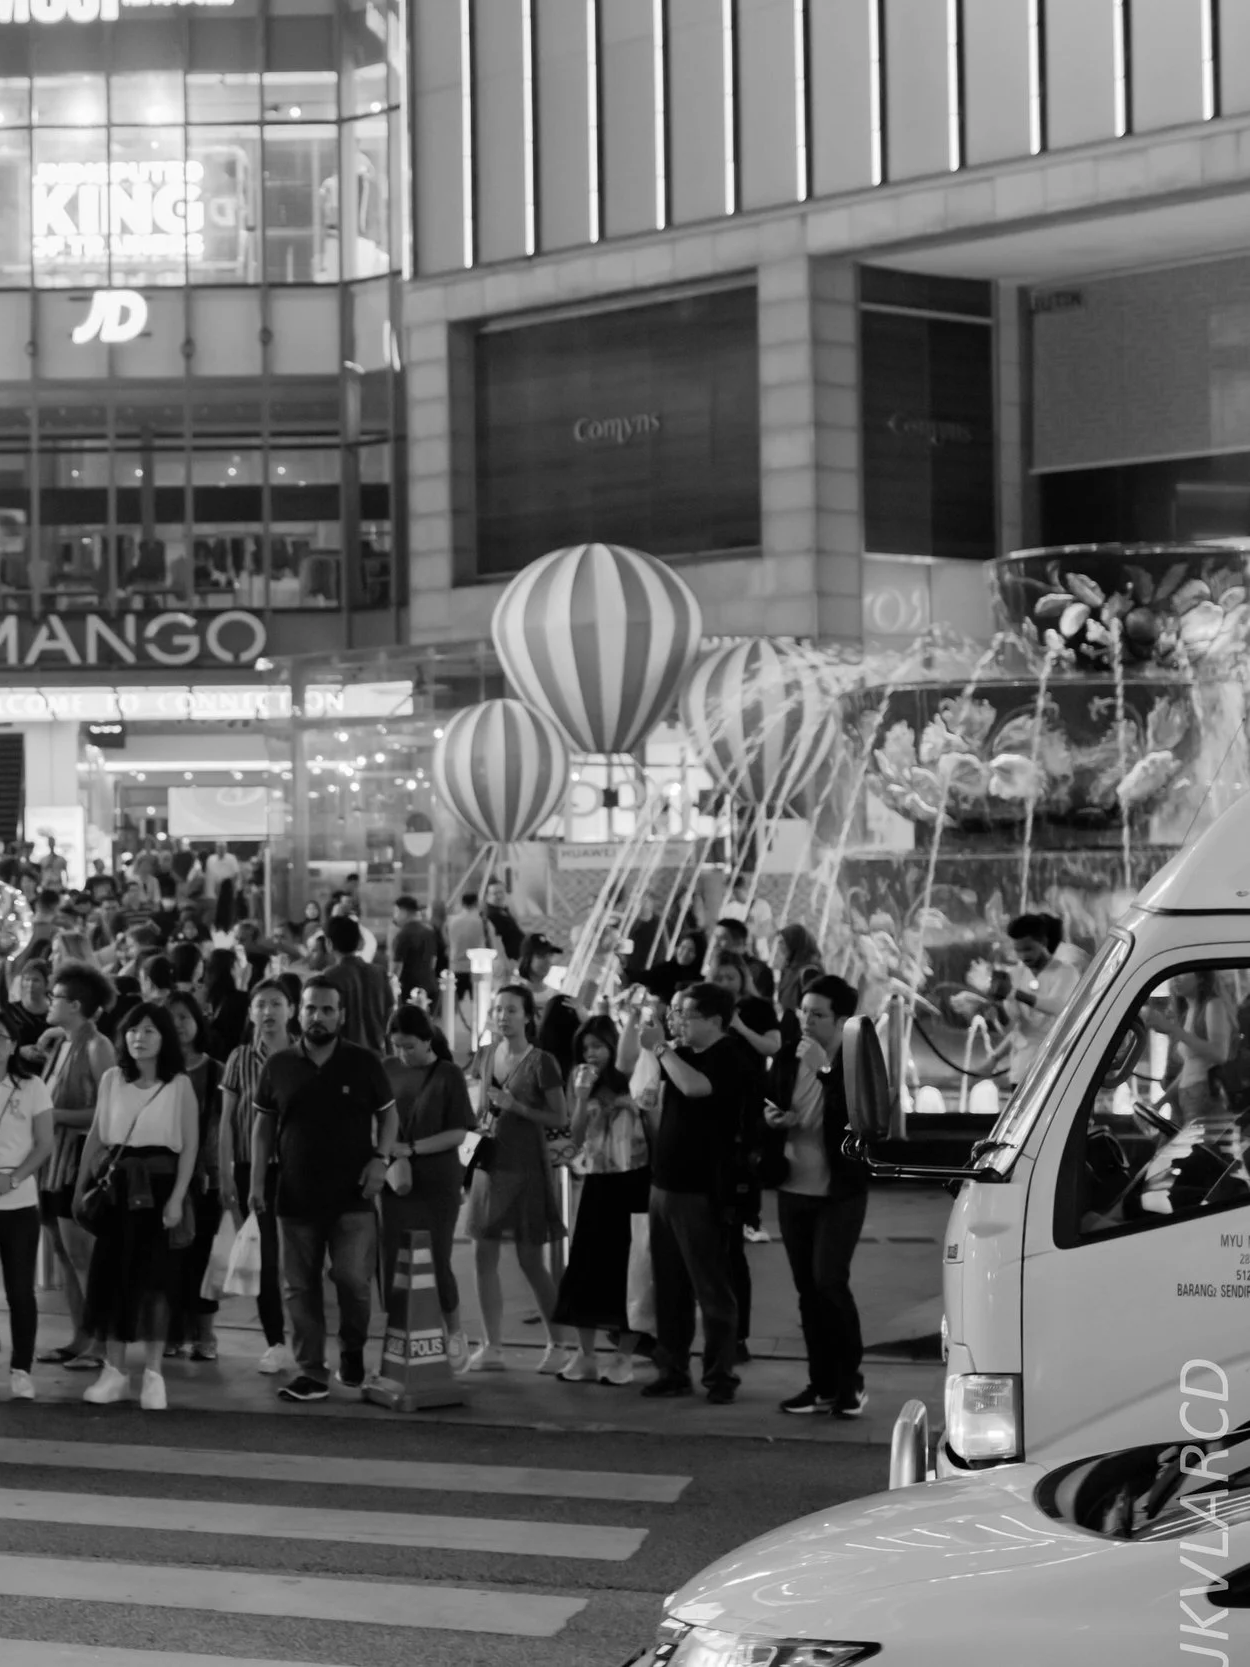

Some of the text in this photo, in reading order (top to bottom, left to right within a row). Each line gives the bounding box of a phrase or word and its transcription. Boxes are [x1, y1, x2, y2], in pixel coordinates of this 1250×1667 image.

[33, 184, 204, 236] KING
[72, 290, 148, 344] JD
[106, 693, 141, 714] TO
[155, 690, 344, 714] CONNECTON
[1220, 1234, 1244, 1248] MYU
[410, 1338, 444, 1357] POLIS
